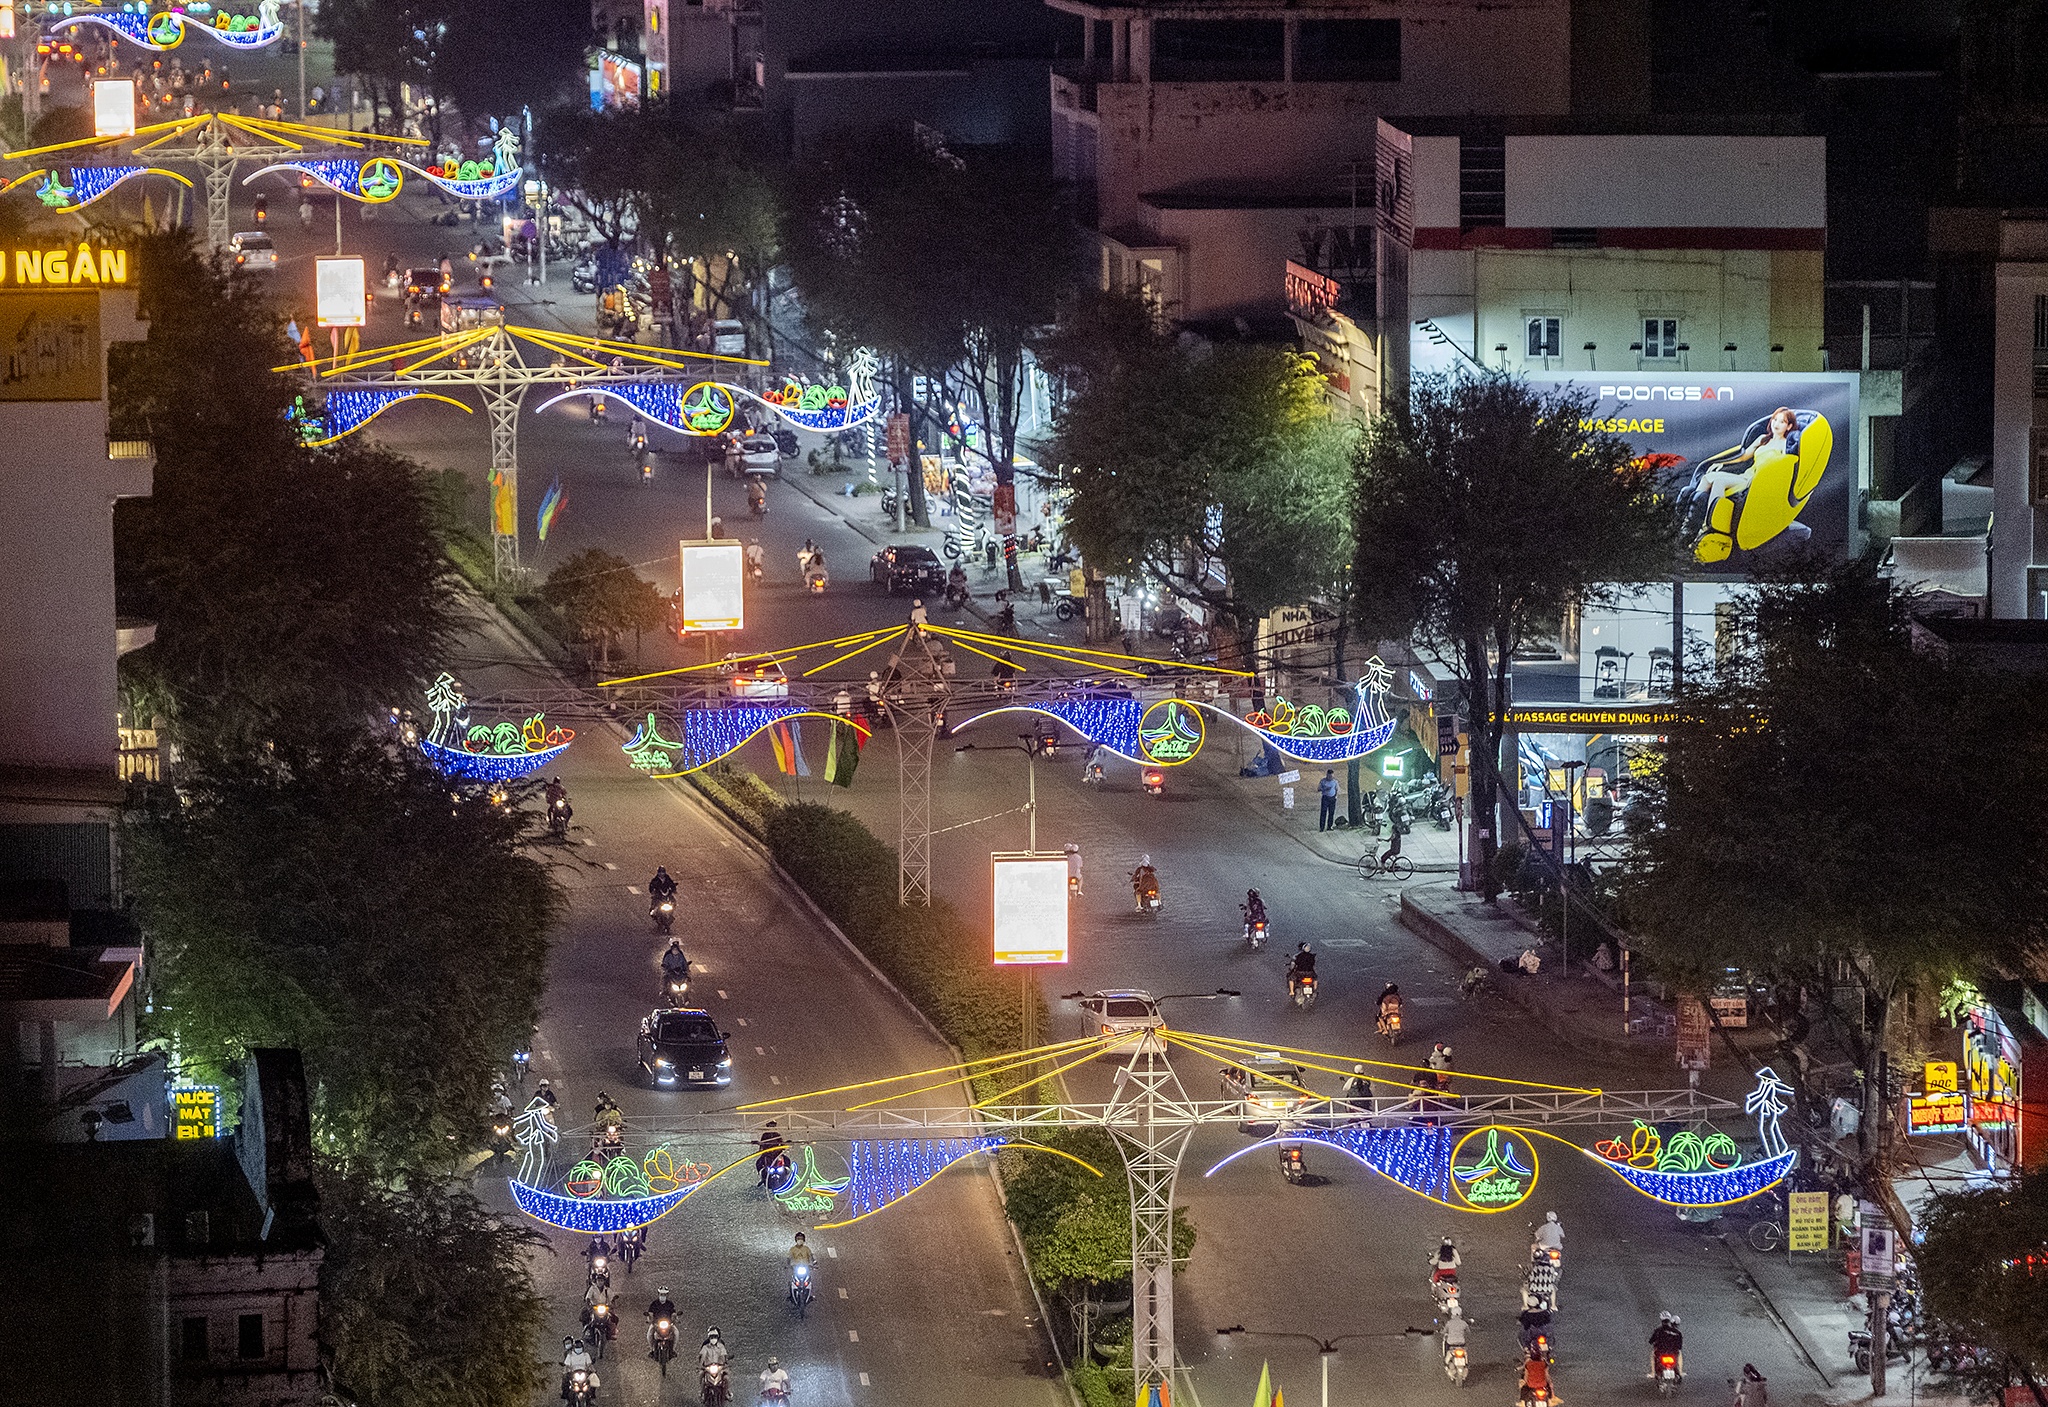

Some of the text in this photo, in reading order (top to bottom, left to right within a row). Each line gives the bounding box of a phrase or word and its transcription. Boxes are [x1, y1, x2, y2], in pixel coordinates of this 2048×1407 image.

[16, 243, 126, 283] NGÂN
[1578, 418, 1665, 433] MASSAGE
[1514, 711, 1567, 723] MASSAGE
[1570, 710, 1616, 723] CHUYÊN
[1619, 712, 1651, 726] DỤNG
